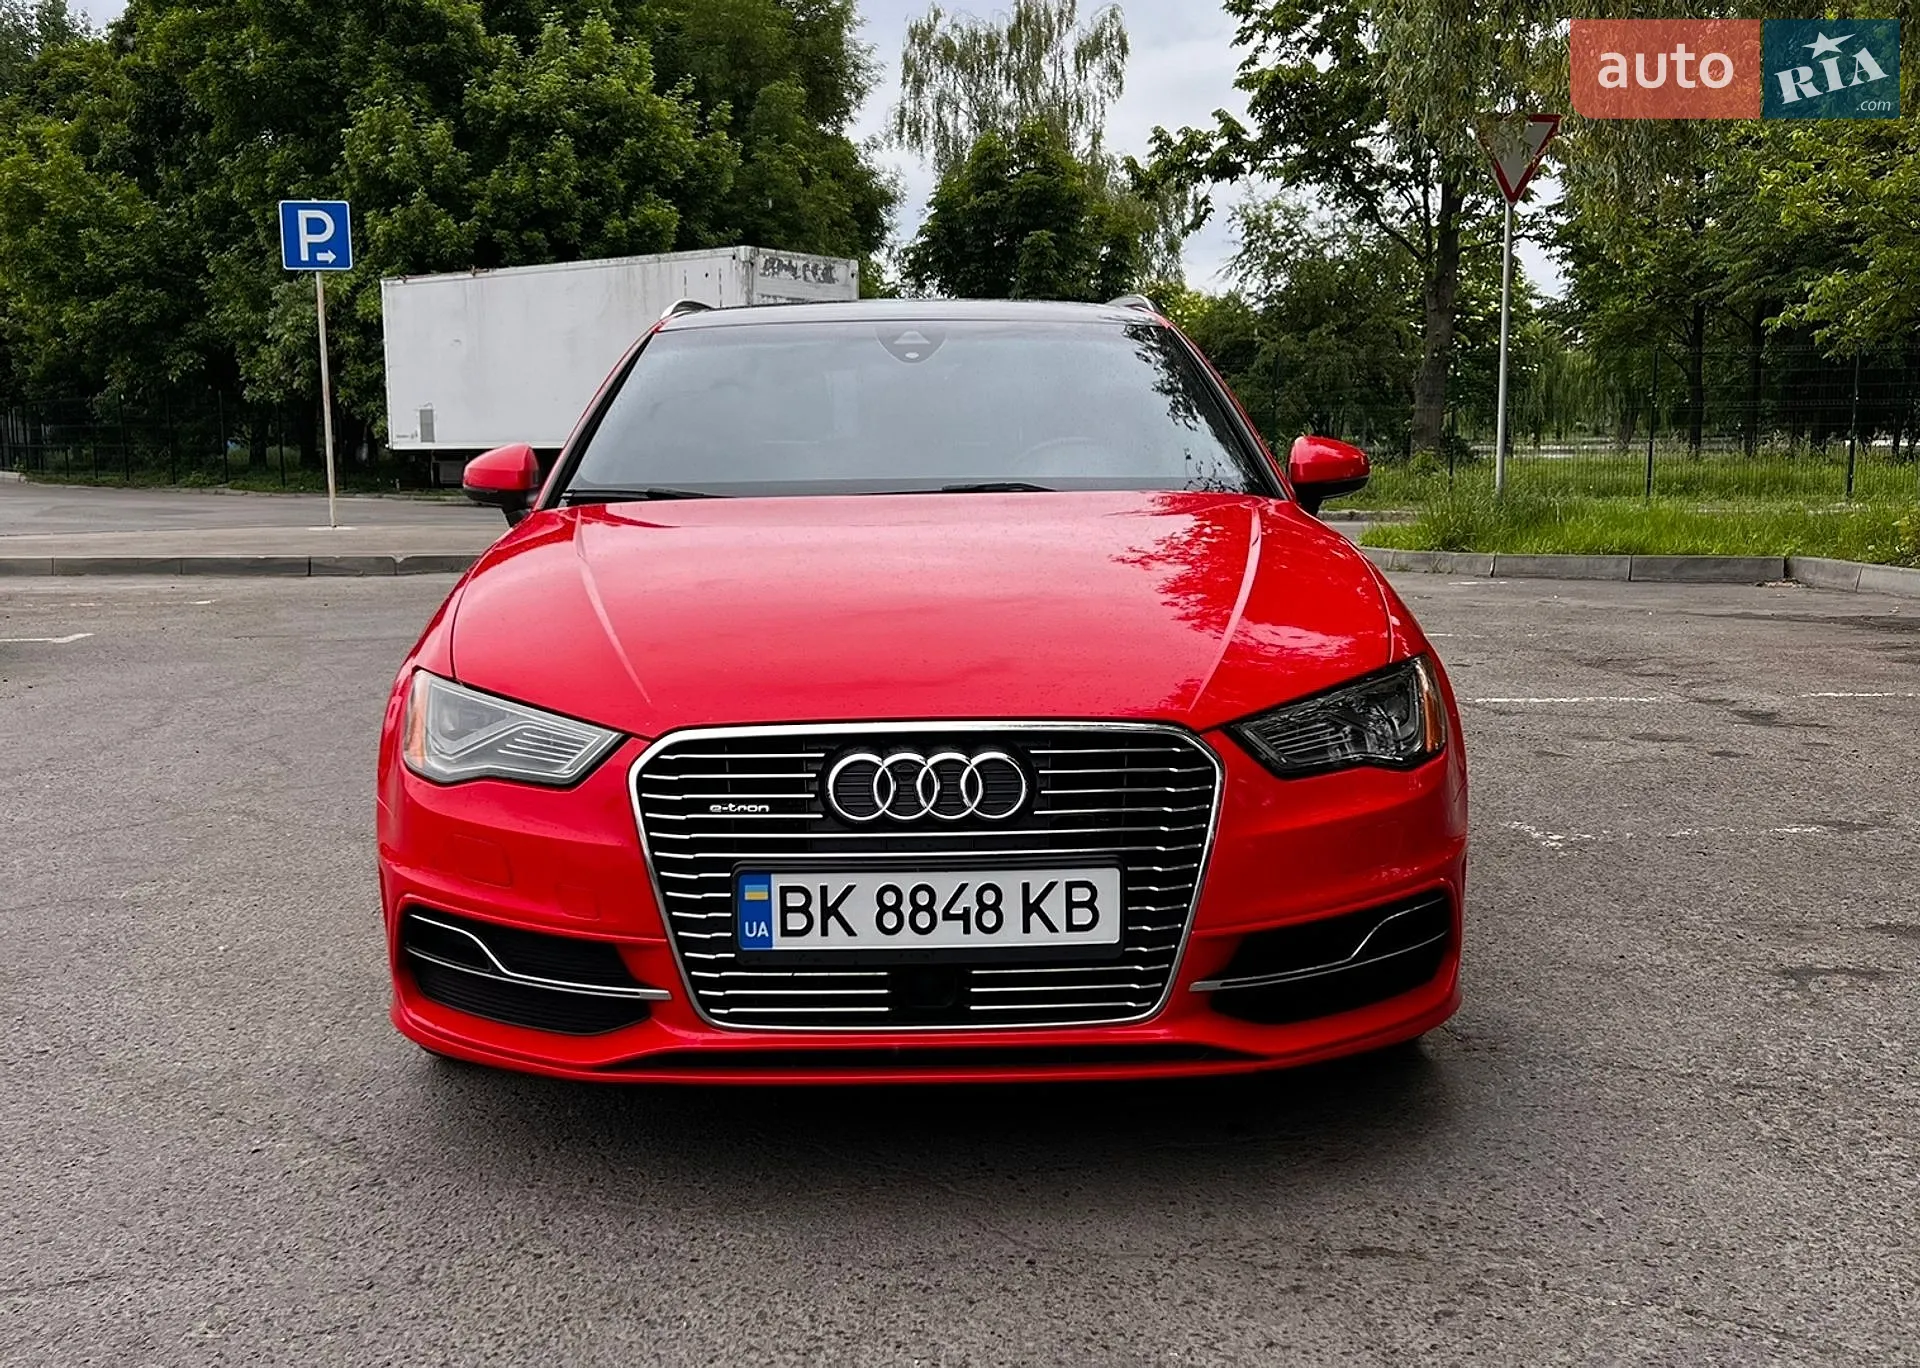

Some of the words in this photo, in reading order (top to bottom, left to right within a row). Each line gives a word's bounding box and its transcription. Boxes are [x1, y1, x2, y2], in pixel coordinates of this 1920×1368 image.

[298, 210, 335, 261] P
[710, 803, 769, 812] e-tron
[778, 884, 857, 937] BK
[875, 882, 1004, 936] 8848
[1021, 880, 1100, 934] KB
[745, 922, 769, 938] UA
